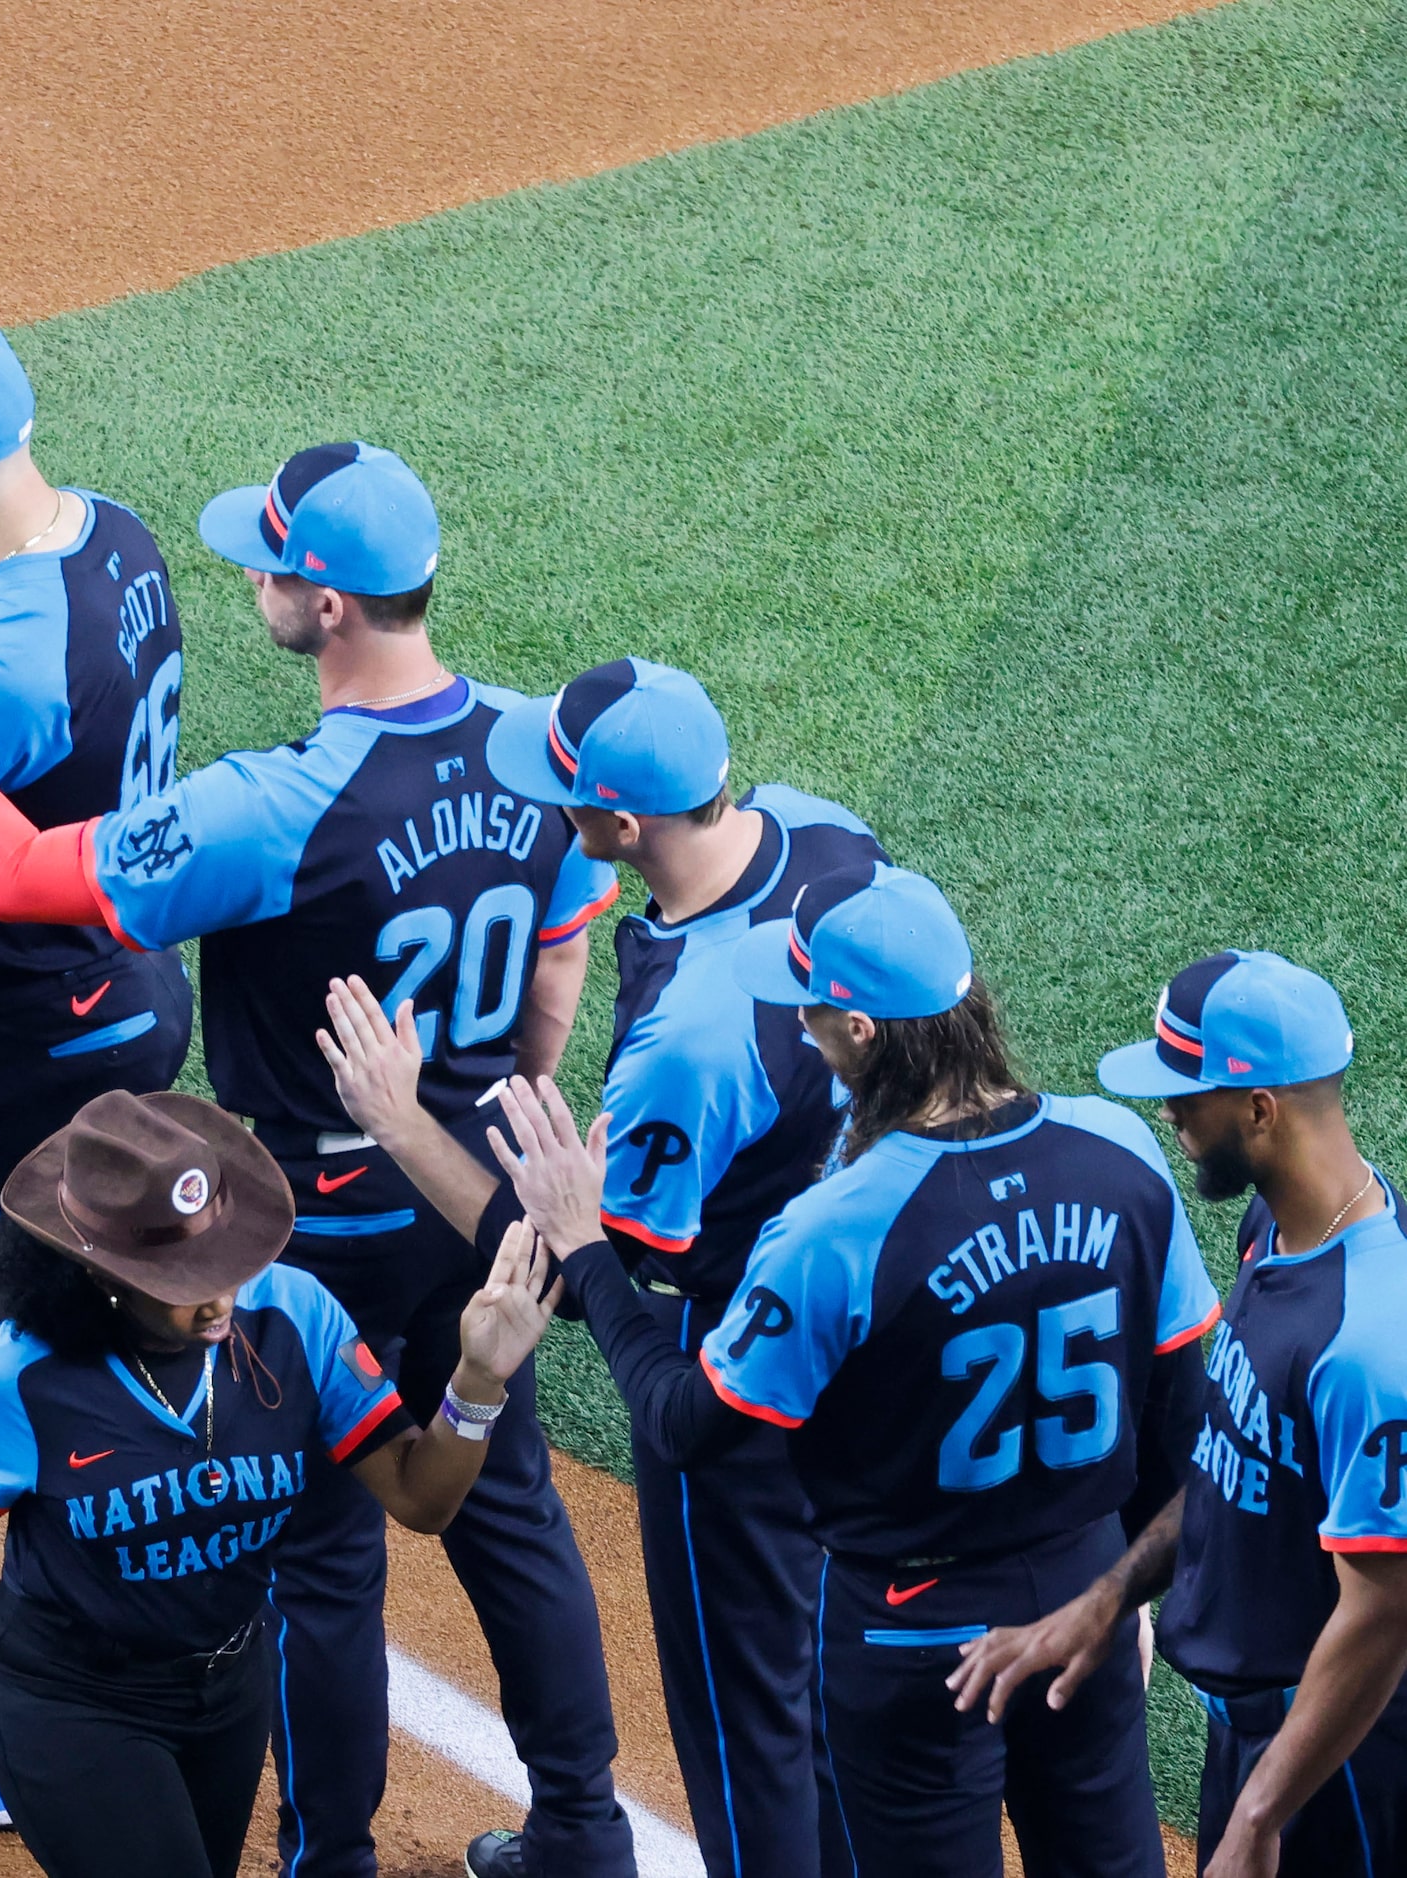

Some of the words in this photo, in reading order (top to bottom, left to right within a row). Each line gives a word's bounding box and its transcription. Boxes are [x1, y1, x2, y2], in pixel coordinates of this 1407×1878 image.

[117, 570, 168, 681] SCOTT
[376, 791, 544, 895] ALONSO
[374, 882, 538, 1065] 20
[628, 1121, 692, 1197] P
[926, 1202, 1120, 1316] STRAHM
[727, 1284, 795, 1360] P
[936, 1284, 1122, 1494] 25
